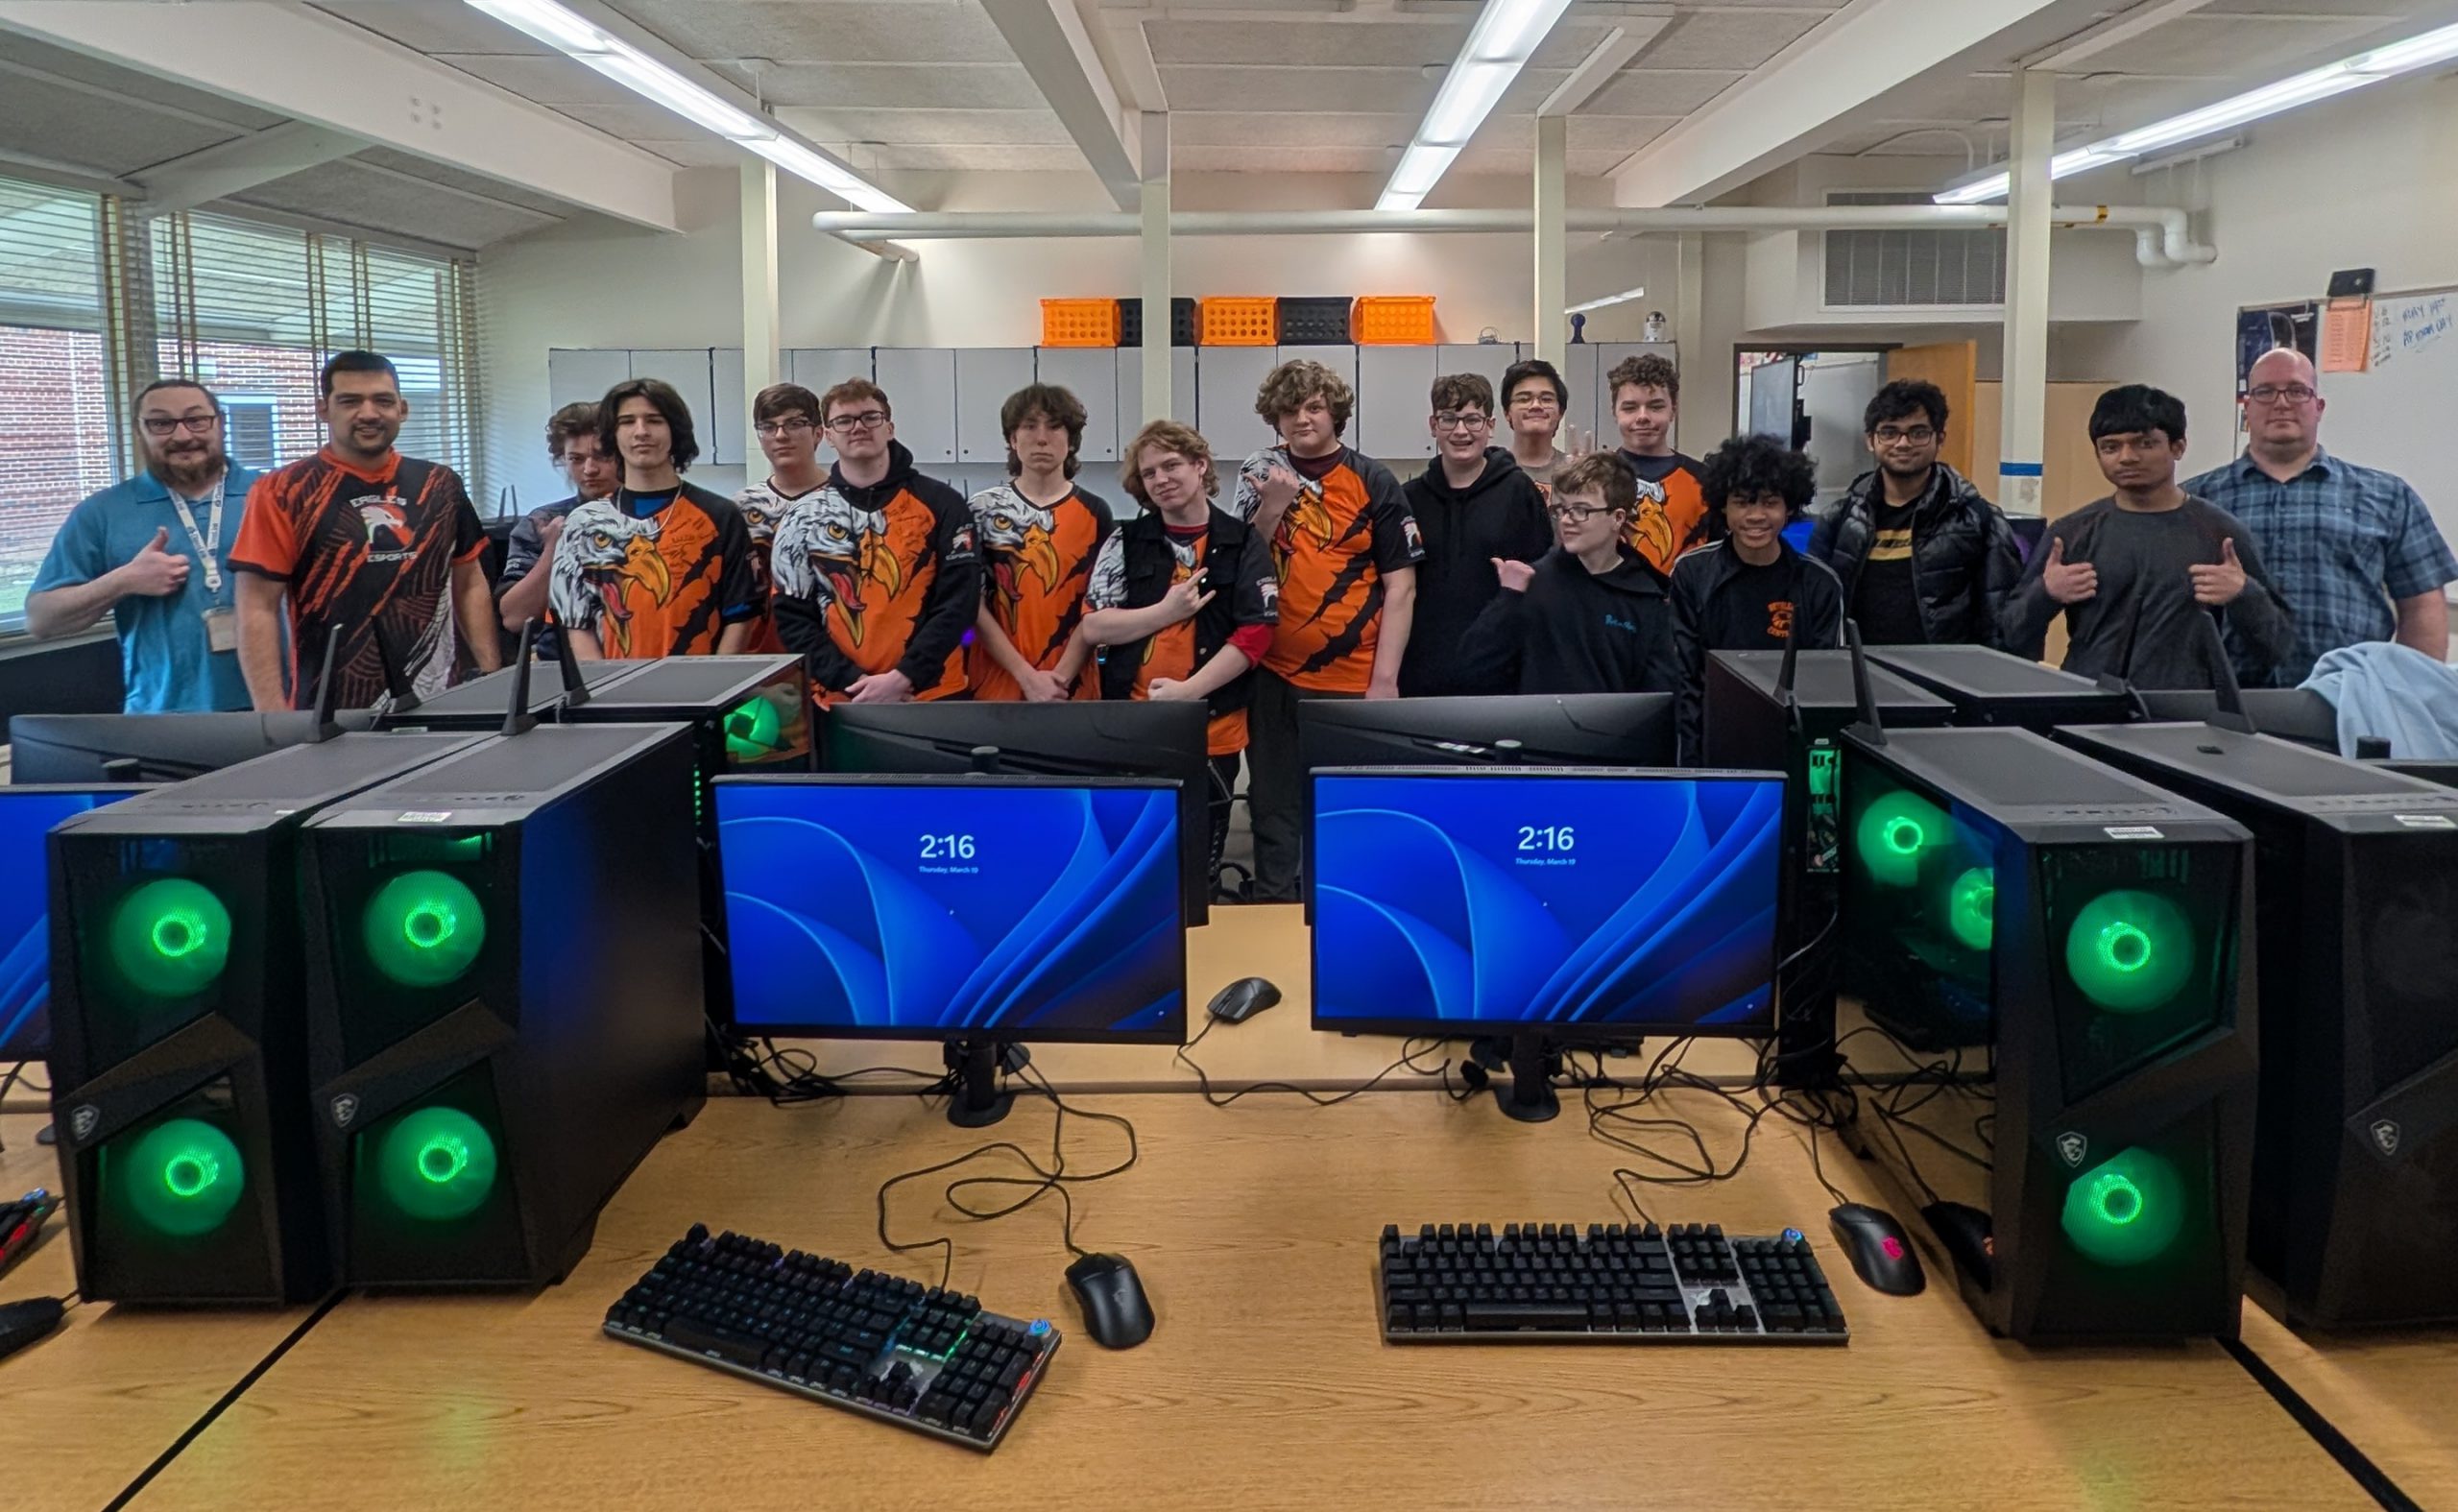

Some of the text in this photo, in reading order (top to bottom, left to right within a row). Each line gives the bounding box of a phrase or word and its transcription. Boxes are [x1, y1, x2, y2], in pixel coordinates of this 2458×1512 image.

[349, 494, 407, 507] EAGLES
[367, 551, 417, 563] ESPORTS
[920, 833, 975, 859] 2:16
[1518, 826, 1574, 851] 2:16
